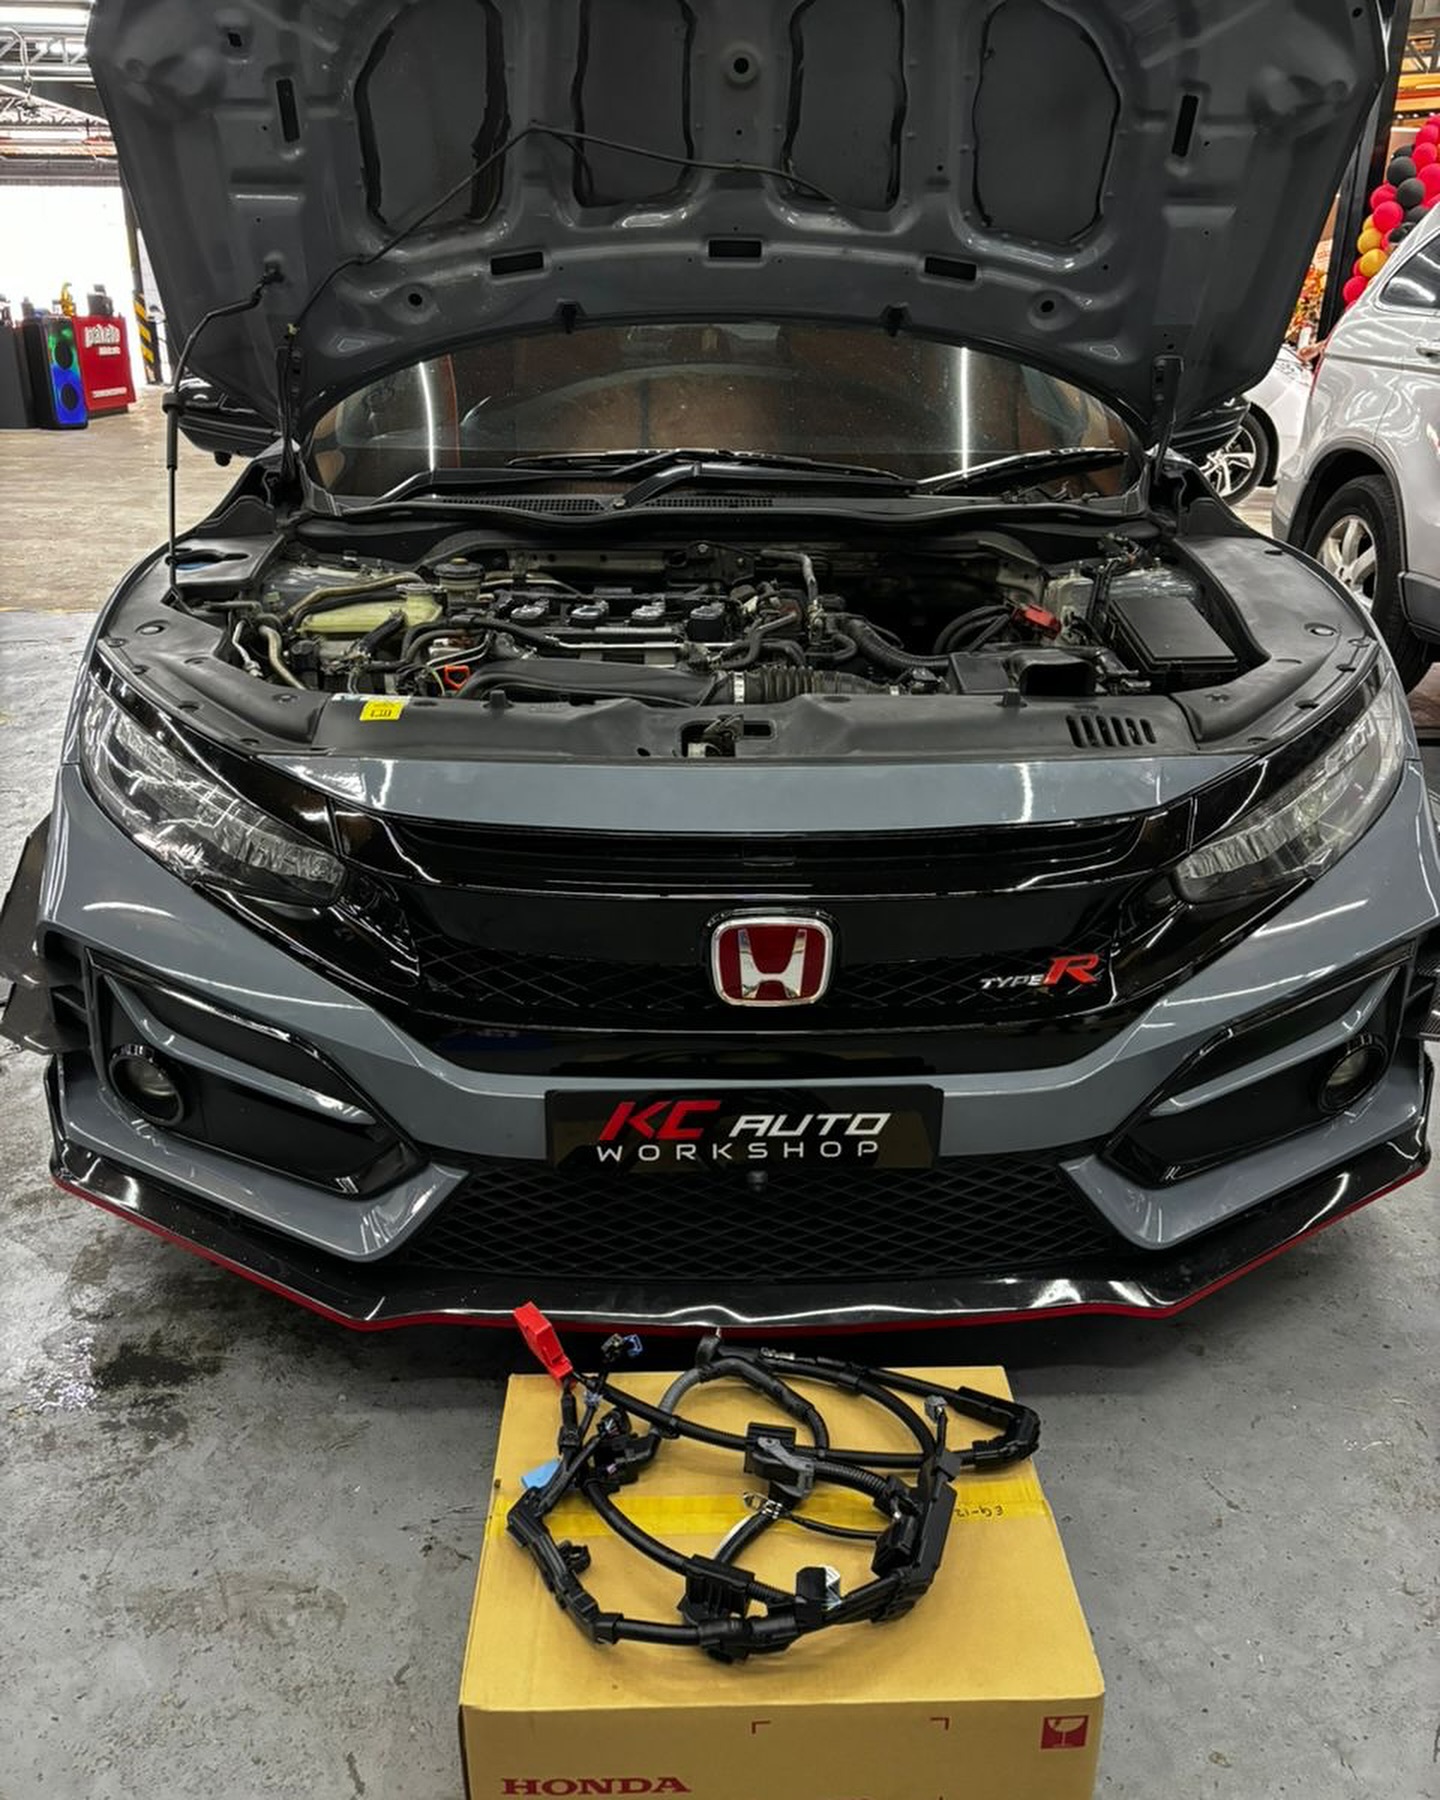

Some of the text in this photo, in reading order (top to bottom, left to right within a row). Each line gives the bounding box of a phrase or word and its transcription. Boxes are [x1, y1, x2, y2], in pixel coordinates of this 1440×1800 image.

[599, 1099, 892, 1141] KC AUTO
[597, 1140, 879, 1163] WORKSHOP
[501, 1777, 692, 1796] HONDA
